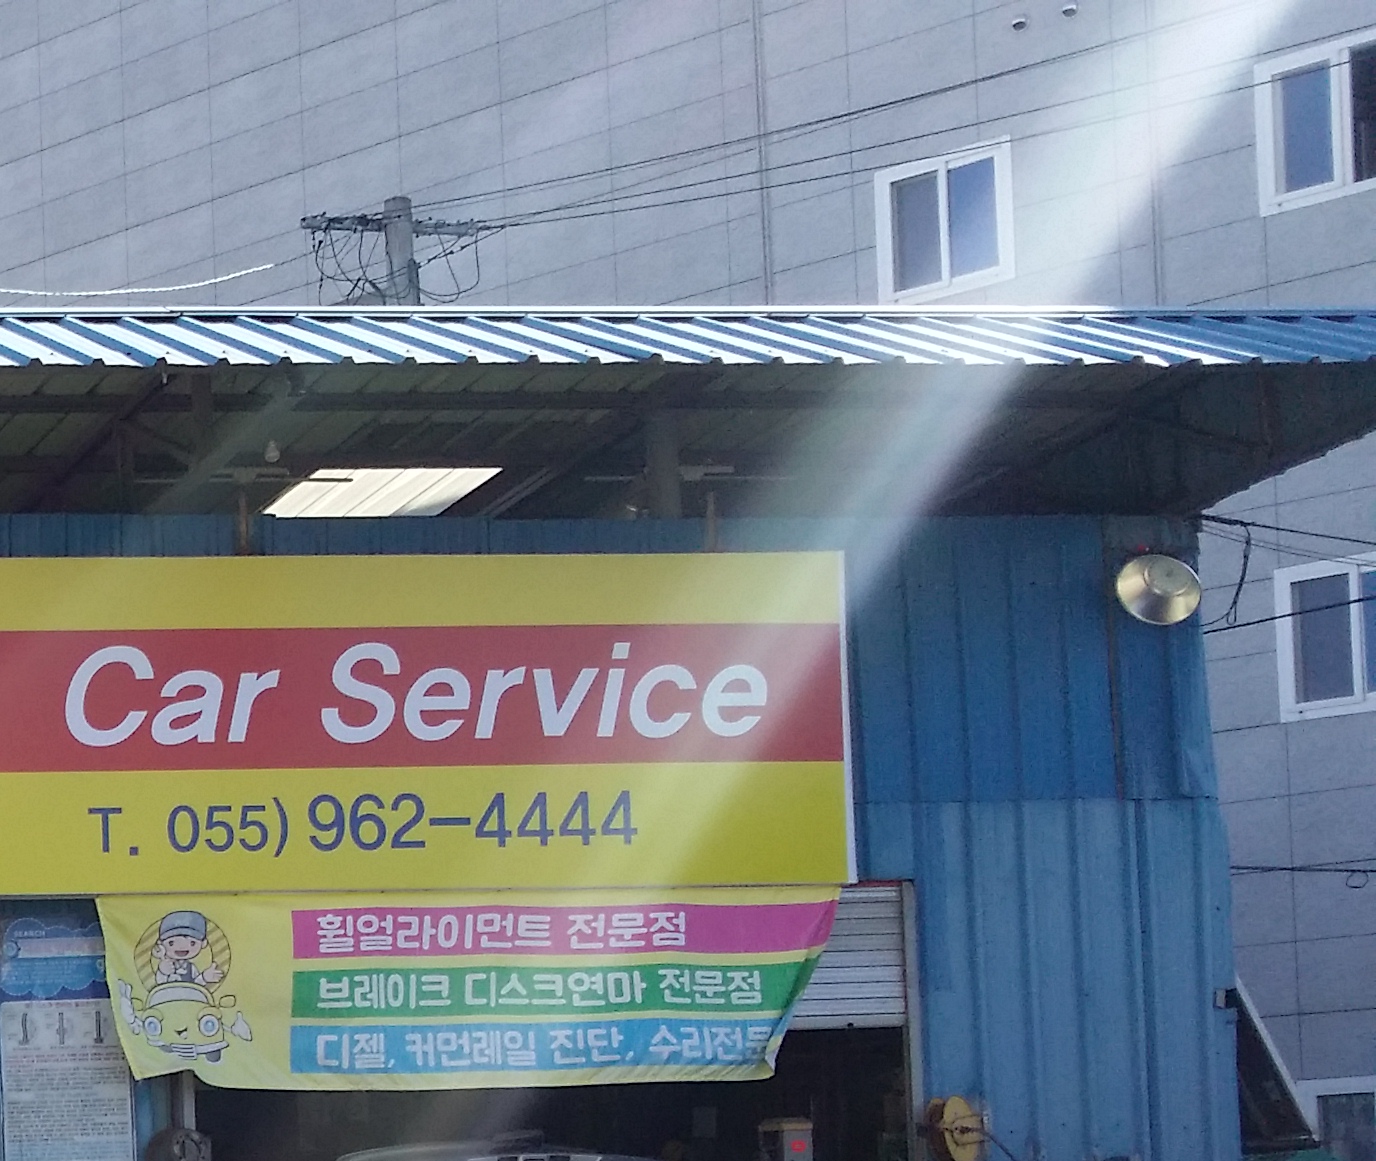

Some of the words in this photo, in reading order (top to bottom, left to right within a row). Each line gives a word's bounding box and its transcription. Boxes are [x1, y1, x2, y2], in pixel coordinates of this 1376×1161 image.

[64, 645, 280, 748] Car
[320, 641, 769, 745] Service
[88, 806, 141, 857] T.
[316, 912, 552, 954] 휠얼라이먼트
[566, 911, 686, 950] 전문점
[316, 973, 452, 1010] 브레이크
[465, 970, 647, 1008] 디스크연마
[658, 968, 763, 1006] 전문점
[316, 1031, 395, 1070] 디젤,
[405, 1029, 537, 1068] 커먼레일
